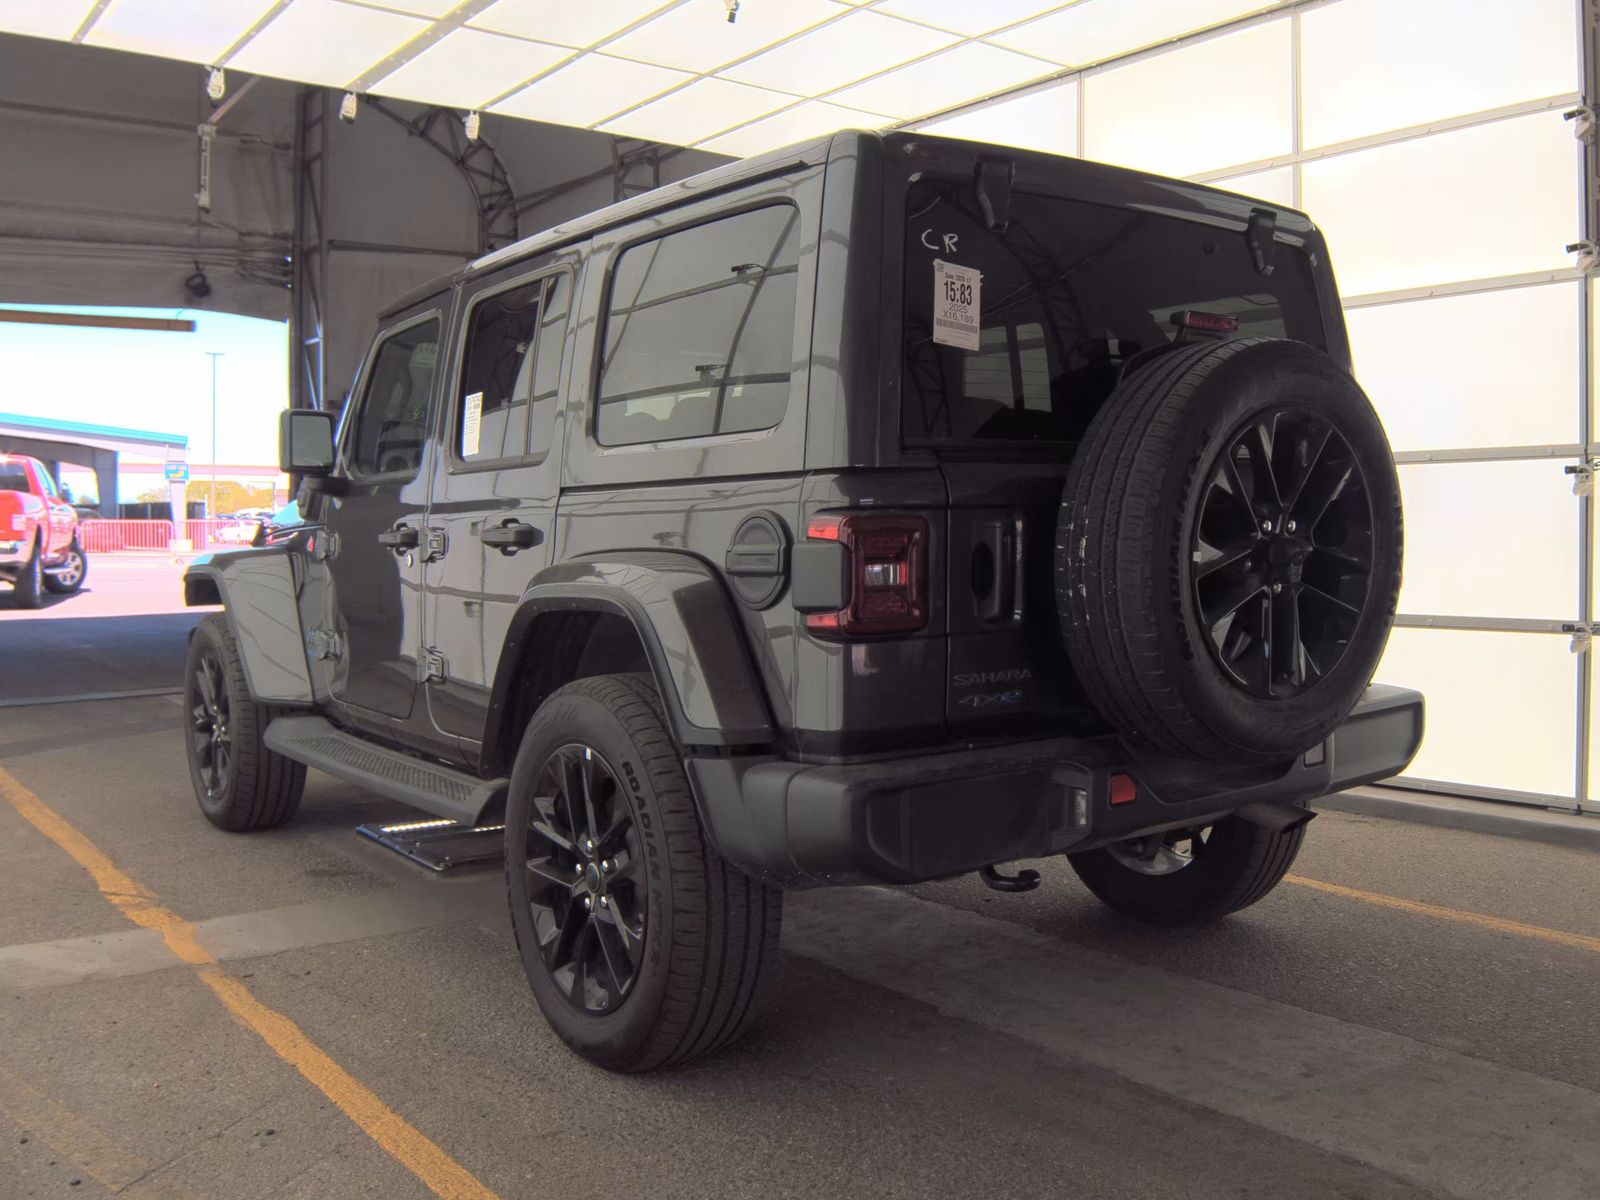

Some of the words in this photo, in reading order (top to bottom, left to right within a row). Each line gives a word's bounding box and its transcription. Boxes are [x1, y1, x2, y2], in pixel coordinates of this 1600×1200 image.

[943, 280, 973, 306] 15:83
[948, 302, 969, 314] 2025
[952, 668, 1032, 687] SAHARA
[621, 760, 662, 881] ROADIAN
